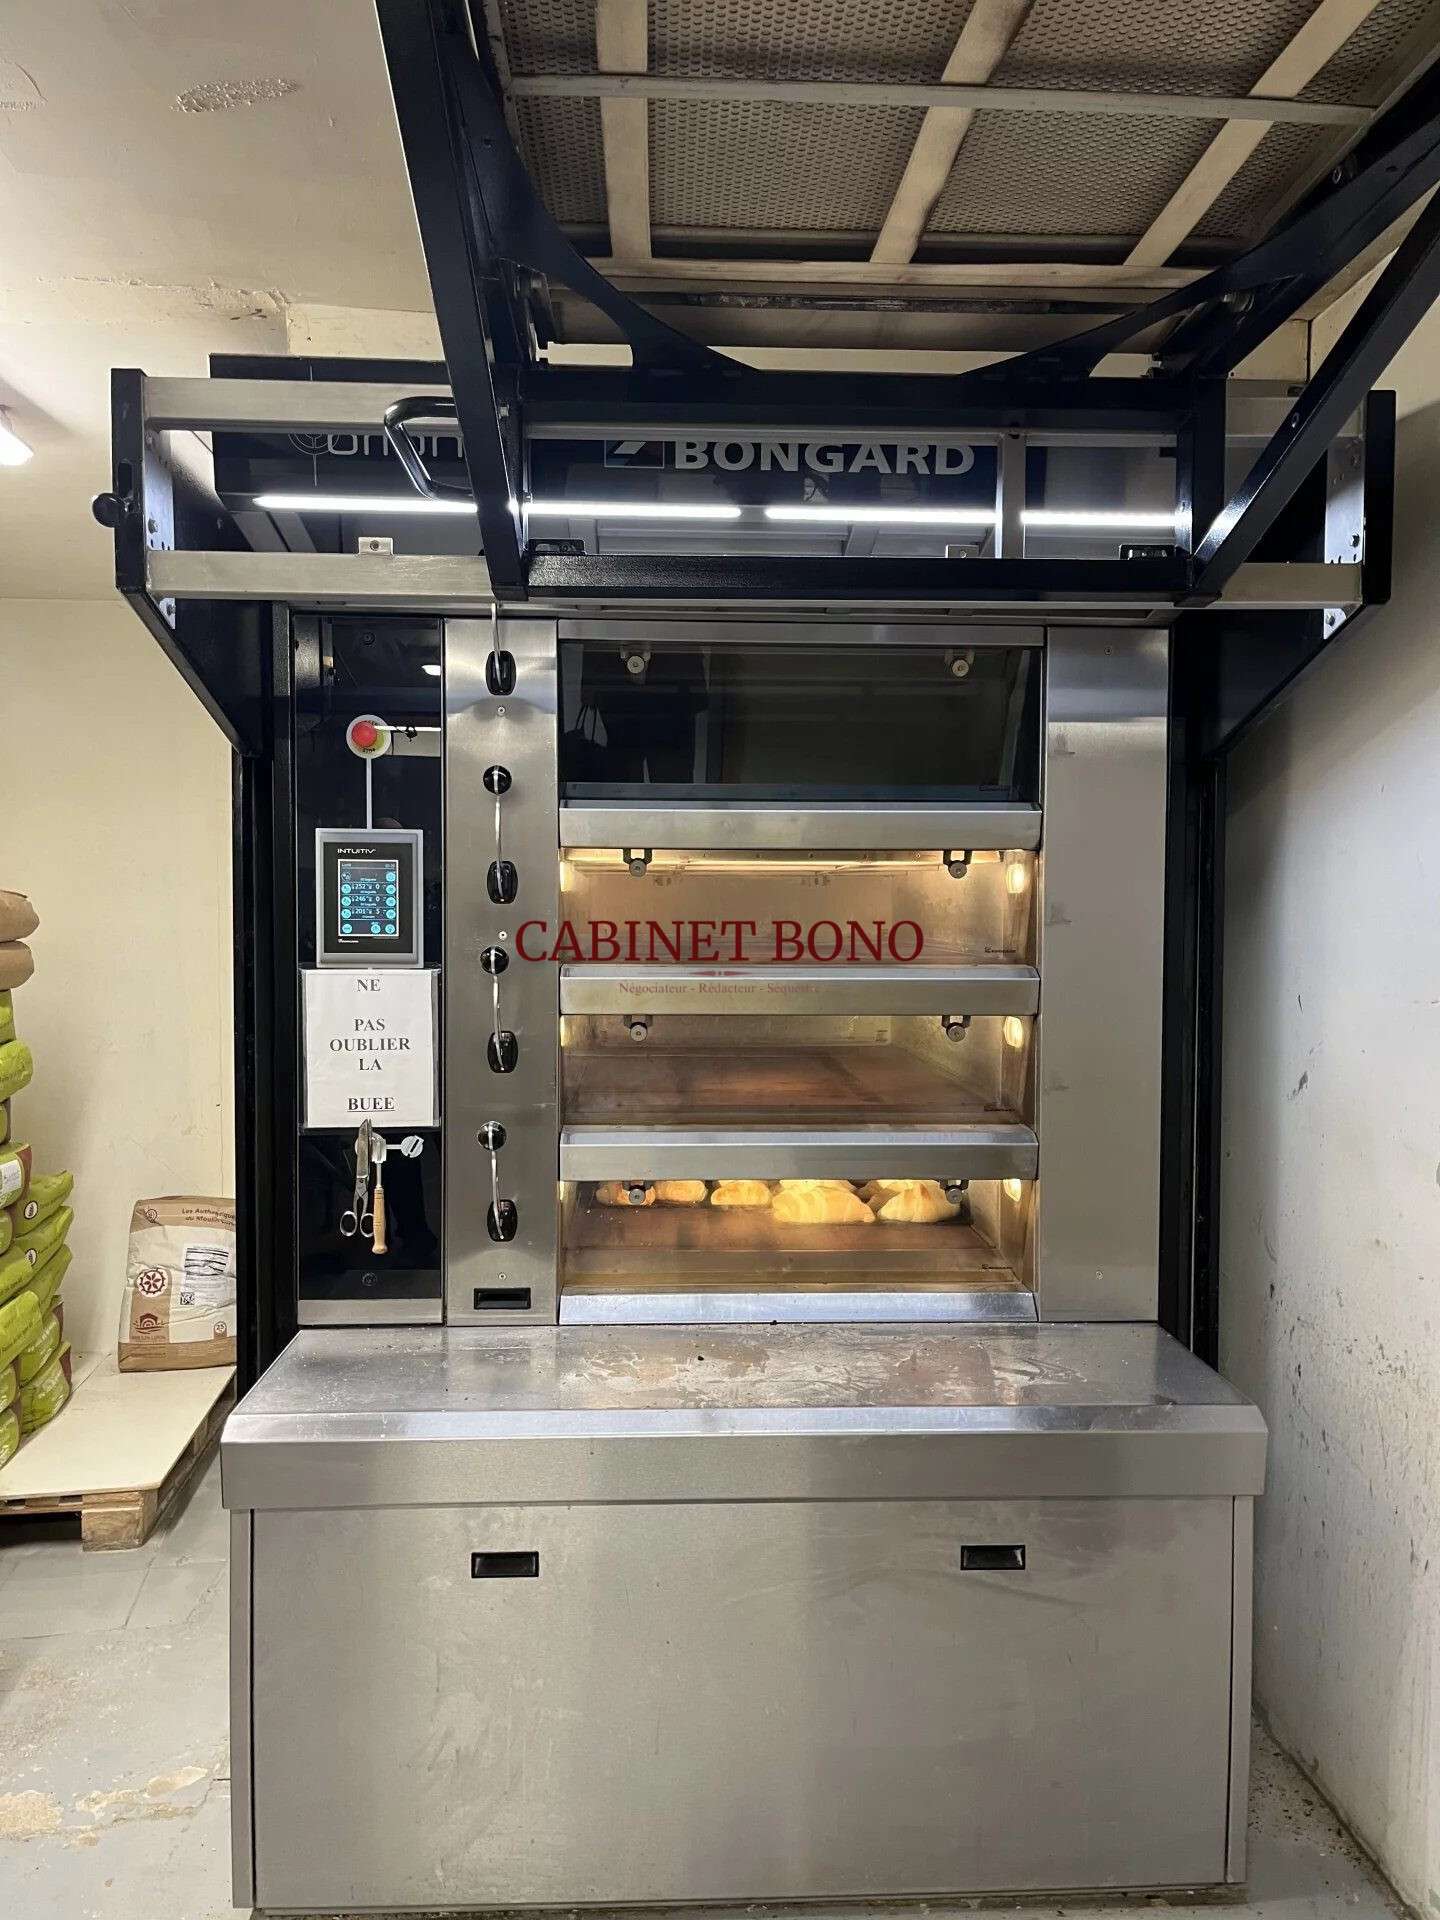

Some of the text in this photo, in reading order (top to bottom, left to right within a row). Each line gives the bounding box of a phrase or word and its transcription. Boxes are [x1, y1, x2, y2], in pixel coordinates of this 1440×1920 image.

[674, 440, 975, 475] BONGARD
[357, 979, 381, 992] NE
[354, 1018, 386, 1031] PAS
[329, 1038, 411, 1051] OUBLIER
[359, 1058, 382, 1071] LA
[347, 1097, 395, 1111] BUEE
